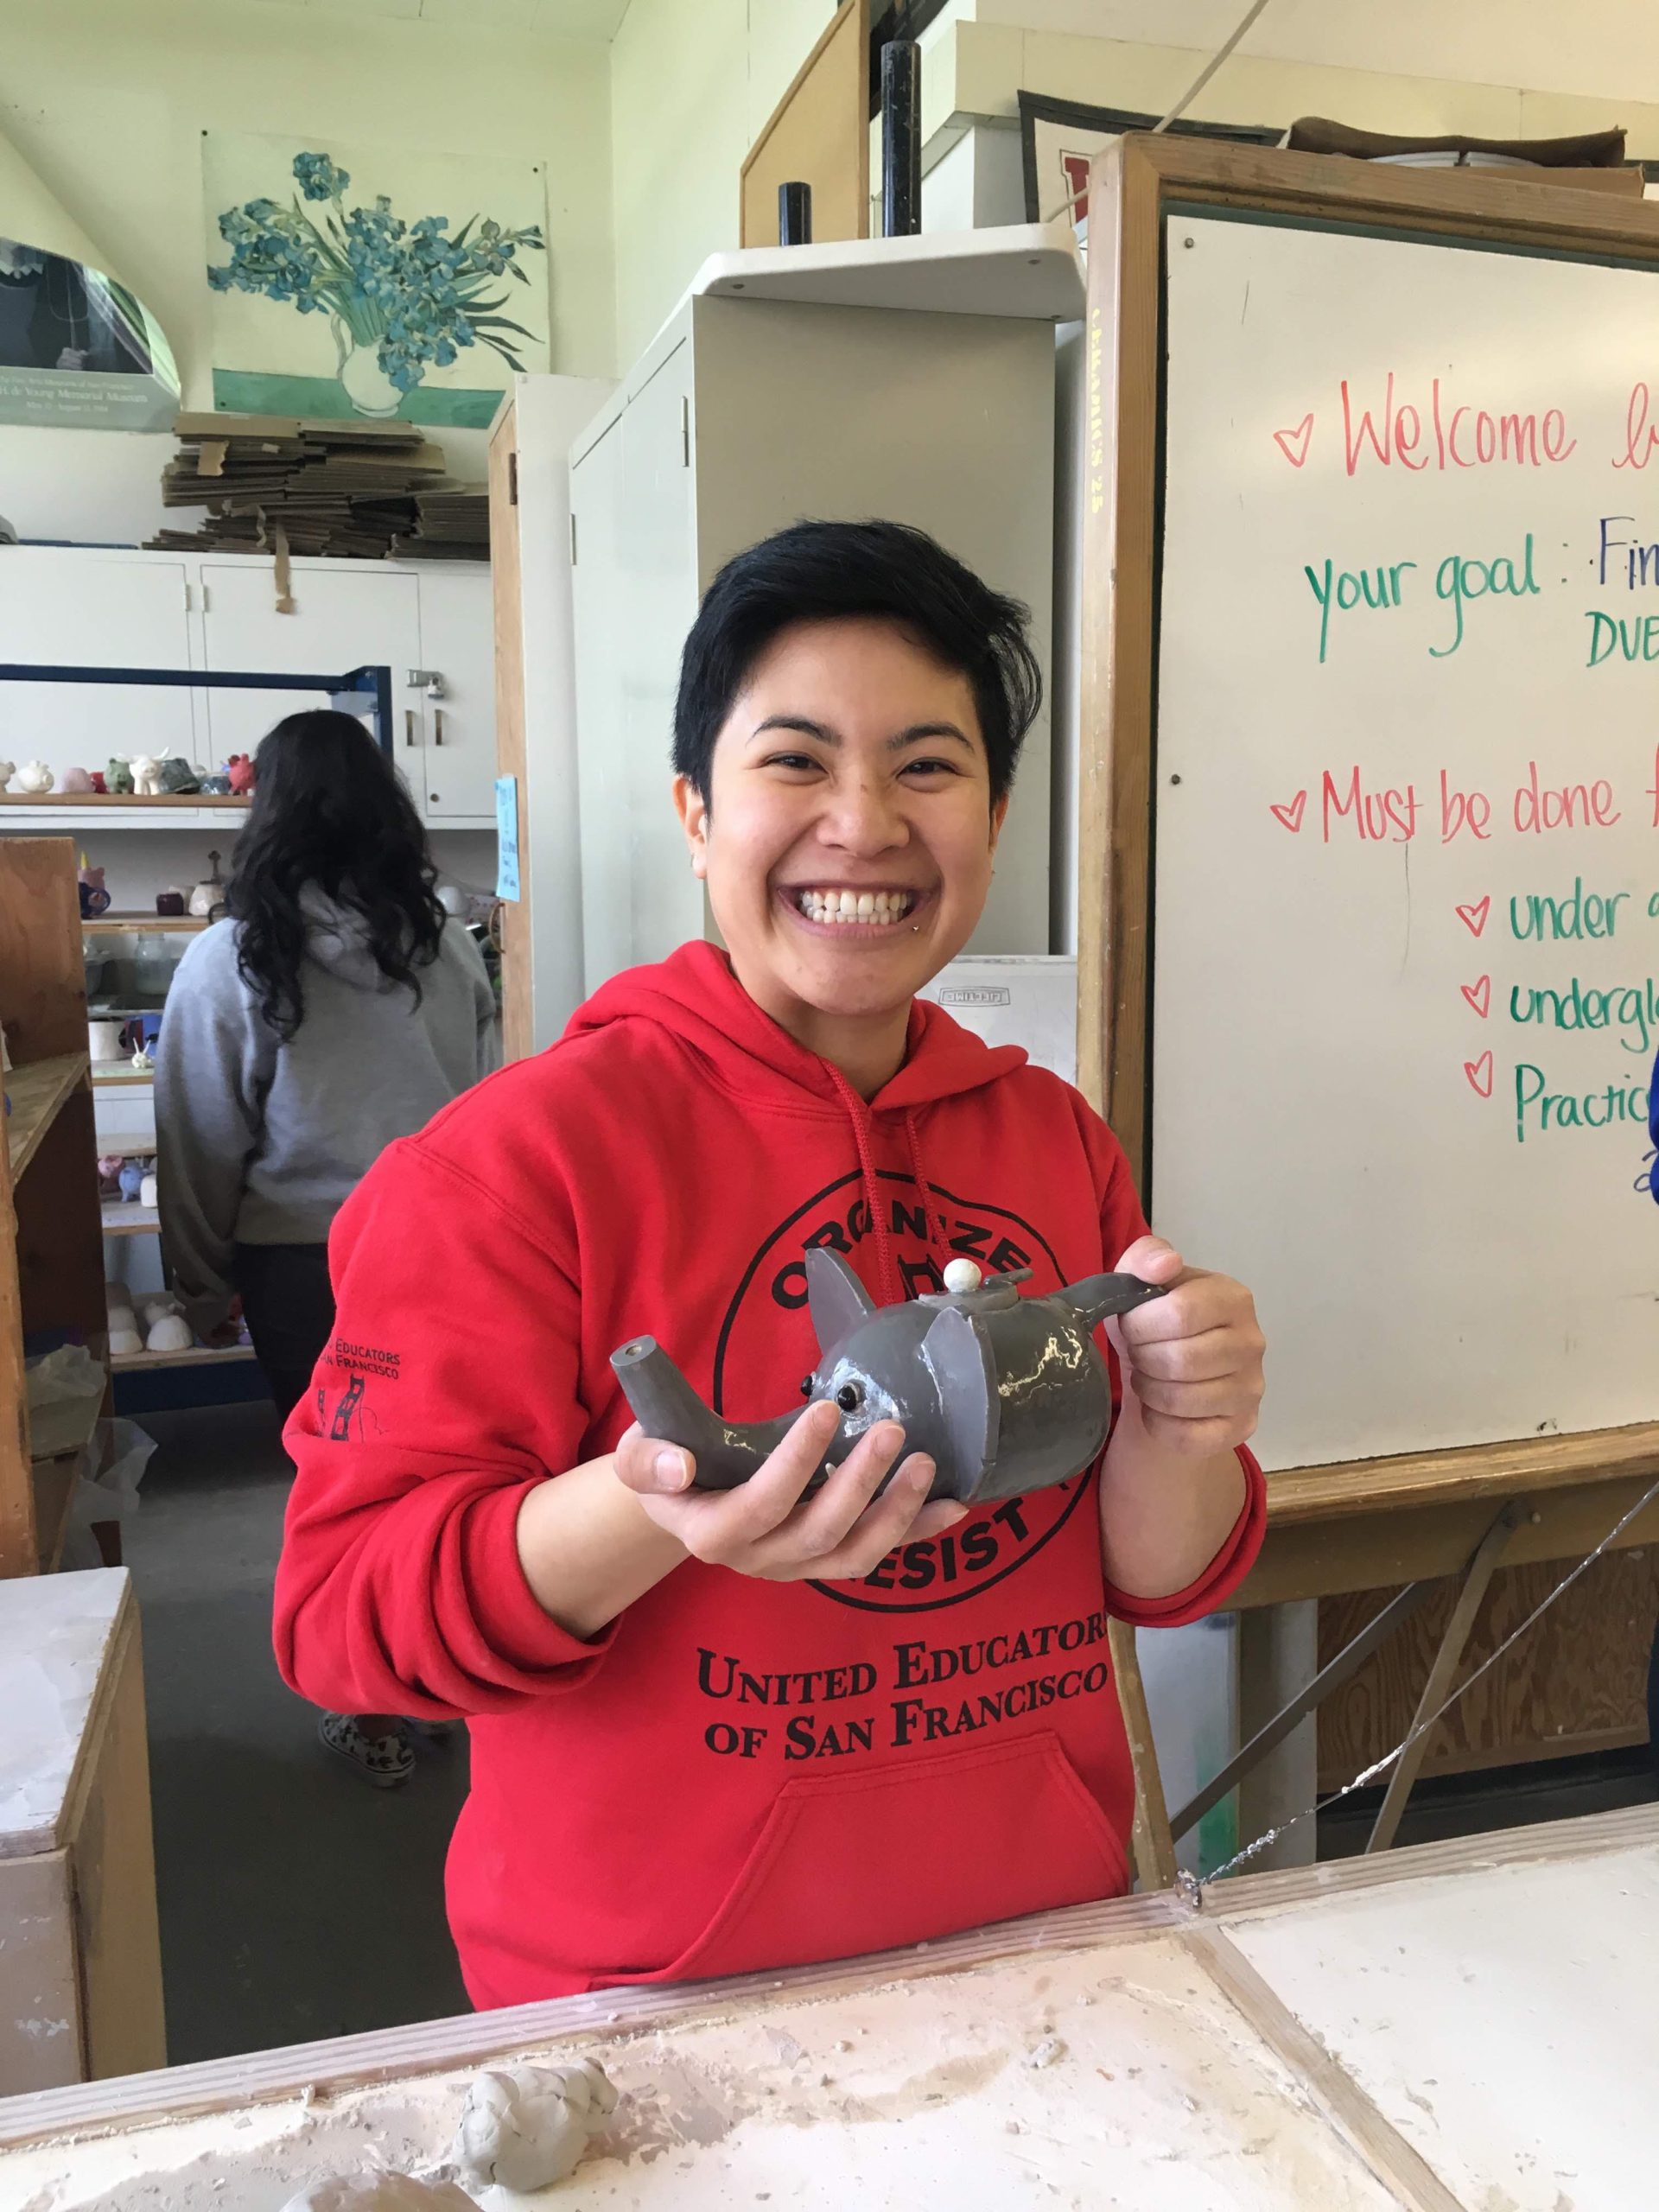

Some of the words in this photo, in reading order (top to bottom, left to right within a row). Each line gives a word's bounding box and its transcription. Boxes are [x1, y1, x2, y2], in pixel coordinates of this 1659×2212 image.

[1341, 372, 1577, 476] Welcome
[1305, 558, 1417, 664] your
[1322, 766, 1424, 844] Must
[1440, 768, 1492, 844] be
[1514, 760, 1622, 834] done
[1510, 876, 1631, 942] under
[1515, 1064, 1649, 1143] Practic
[335, 1338, 401, 1366] EDUCATORS
[335, 1354, 399, 1381] FRANCISCO
[848, 1497, 1029, 1590] ESIST
[696, 1647, 878, 1706] UNITED
[893, 1612, 1108, 1691] EDUCATOR
[704, 1722, 768, 1759] OF
[785, 1715, 875, 1760] SAN
[890, 1662, 1109, 1748] FRANCISCO
